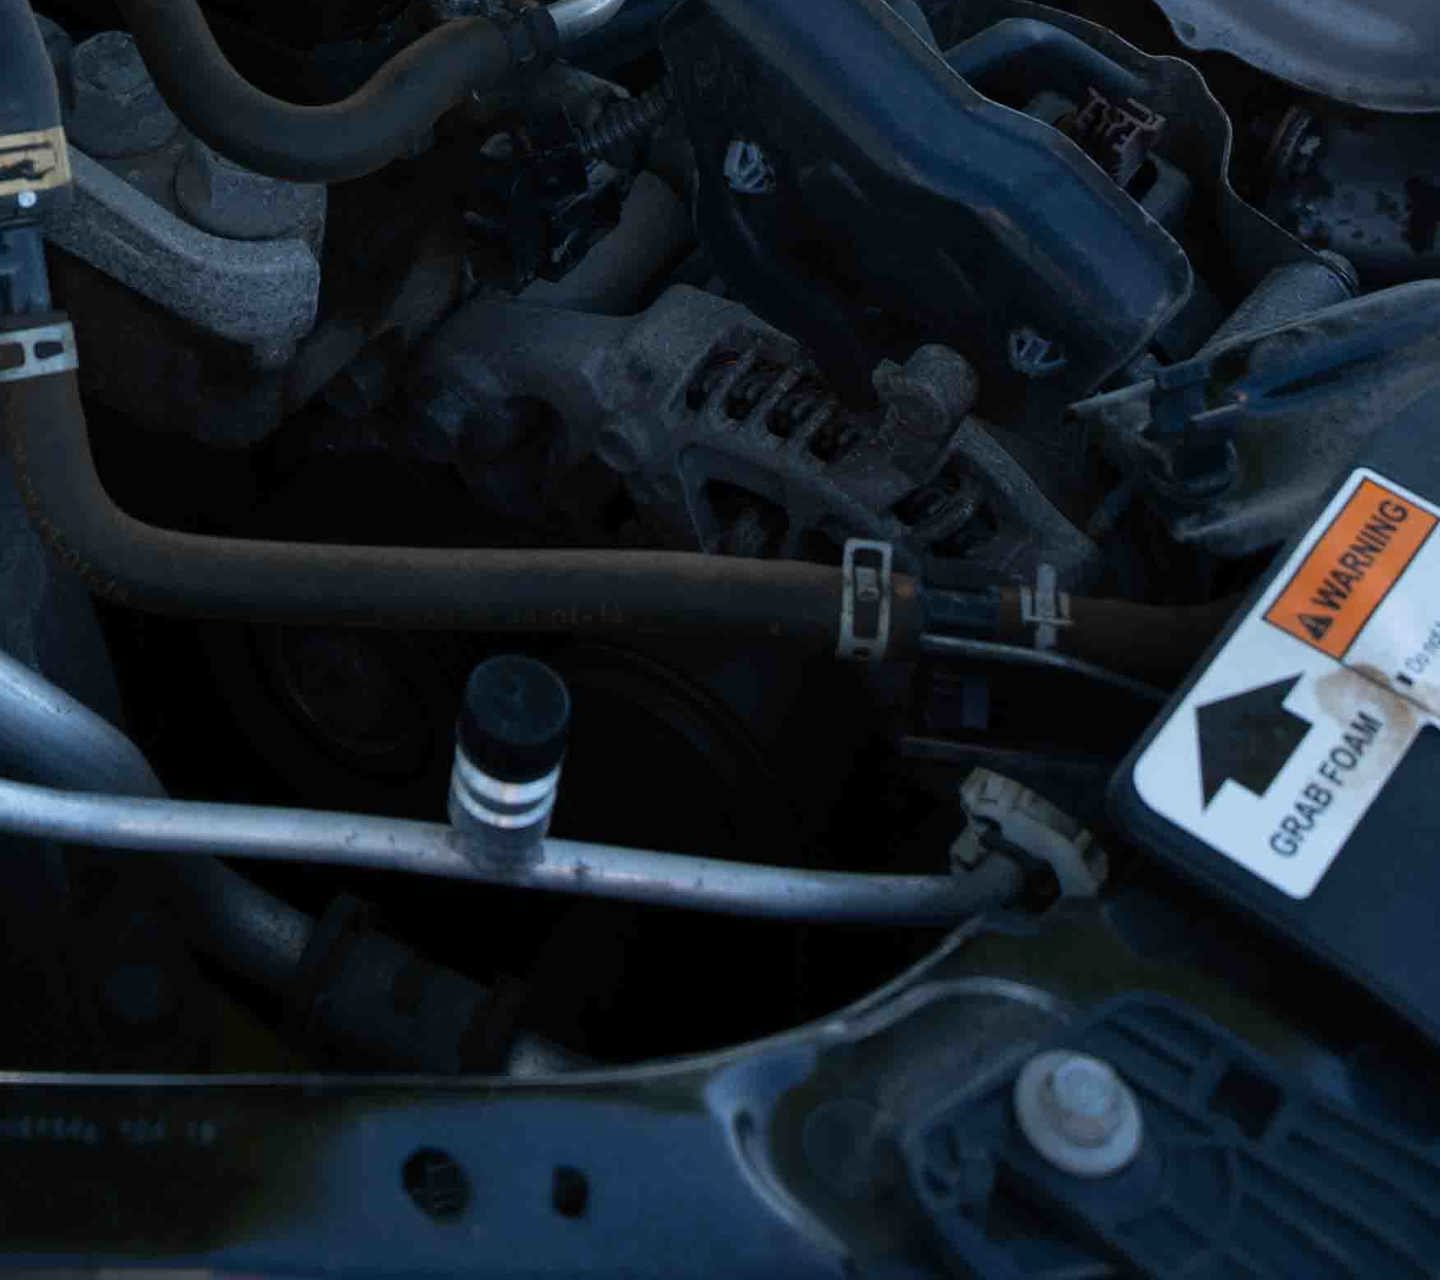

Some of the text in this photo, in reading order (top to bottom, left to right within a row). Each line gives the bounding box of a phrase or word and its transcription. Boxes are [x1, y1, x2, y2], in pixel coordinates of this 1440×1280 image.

[1311, 499, 1408, 611] WARNING
[1270, 711, 1383, 857] GRAB FOAM
